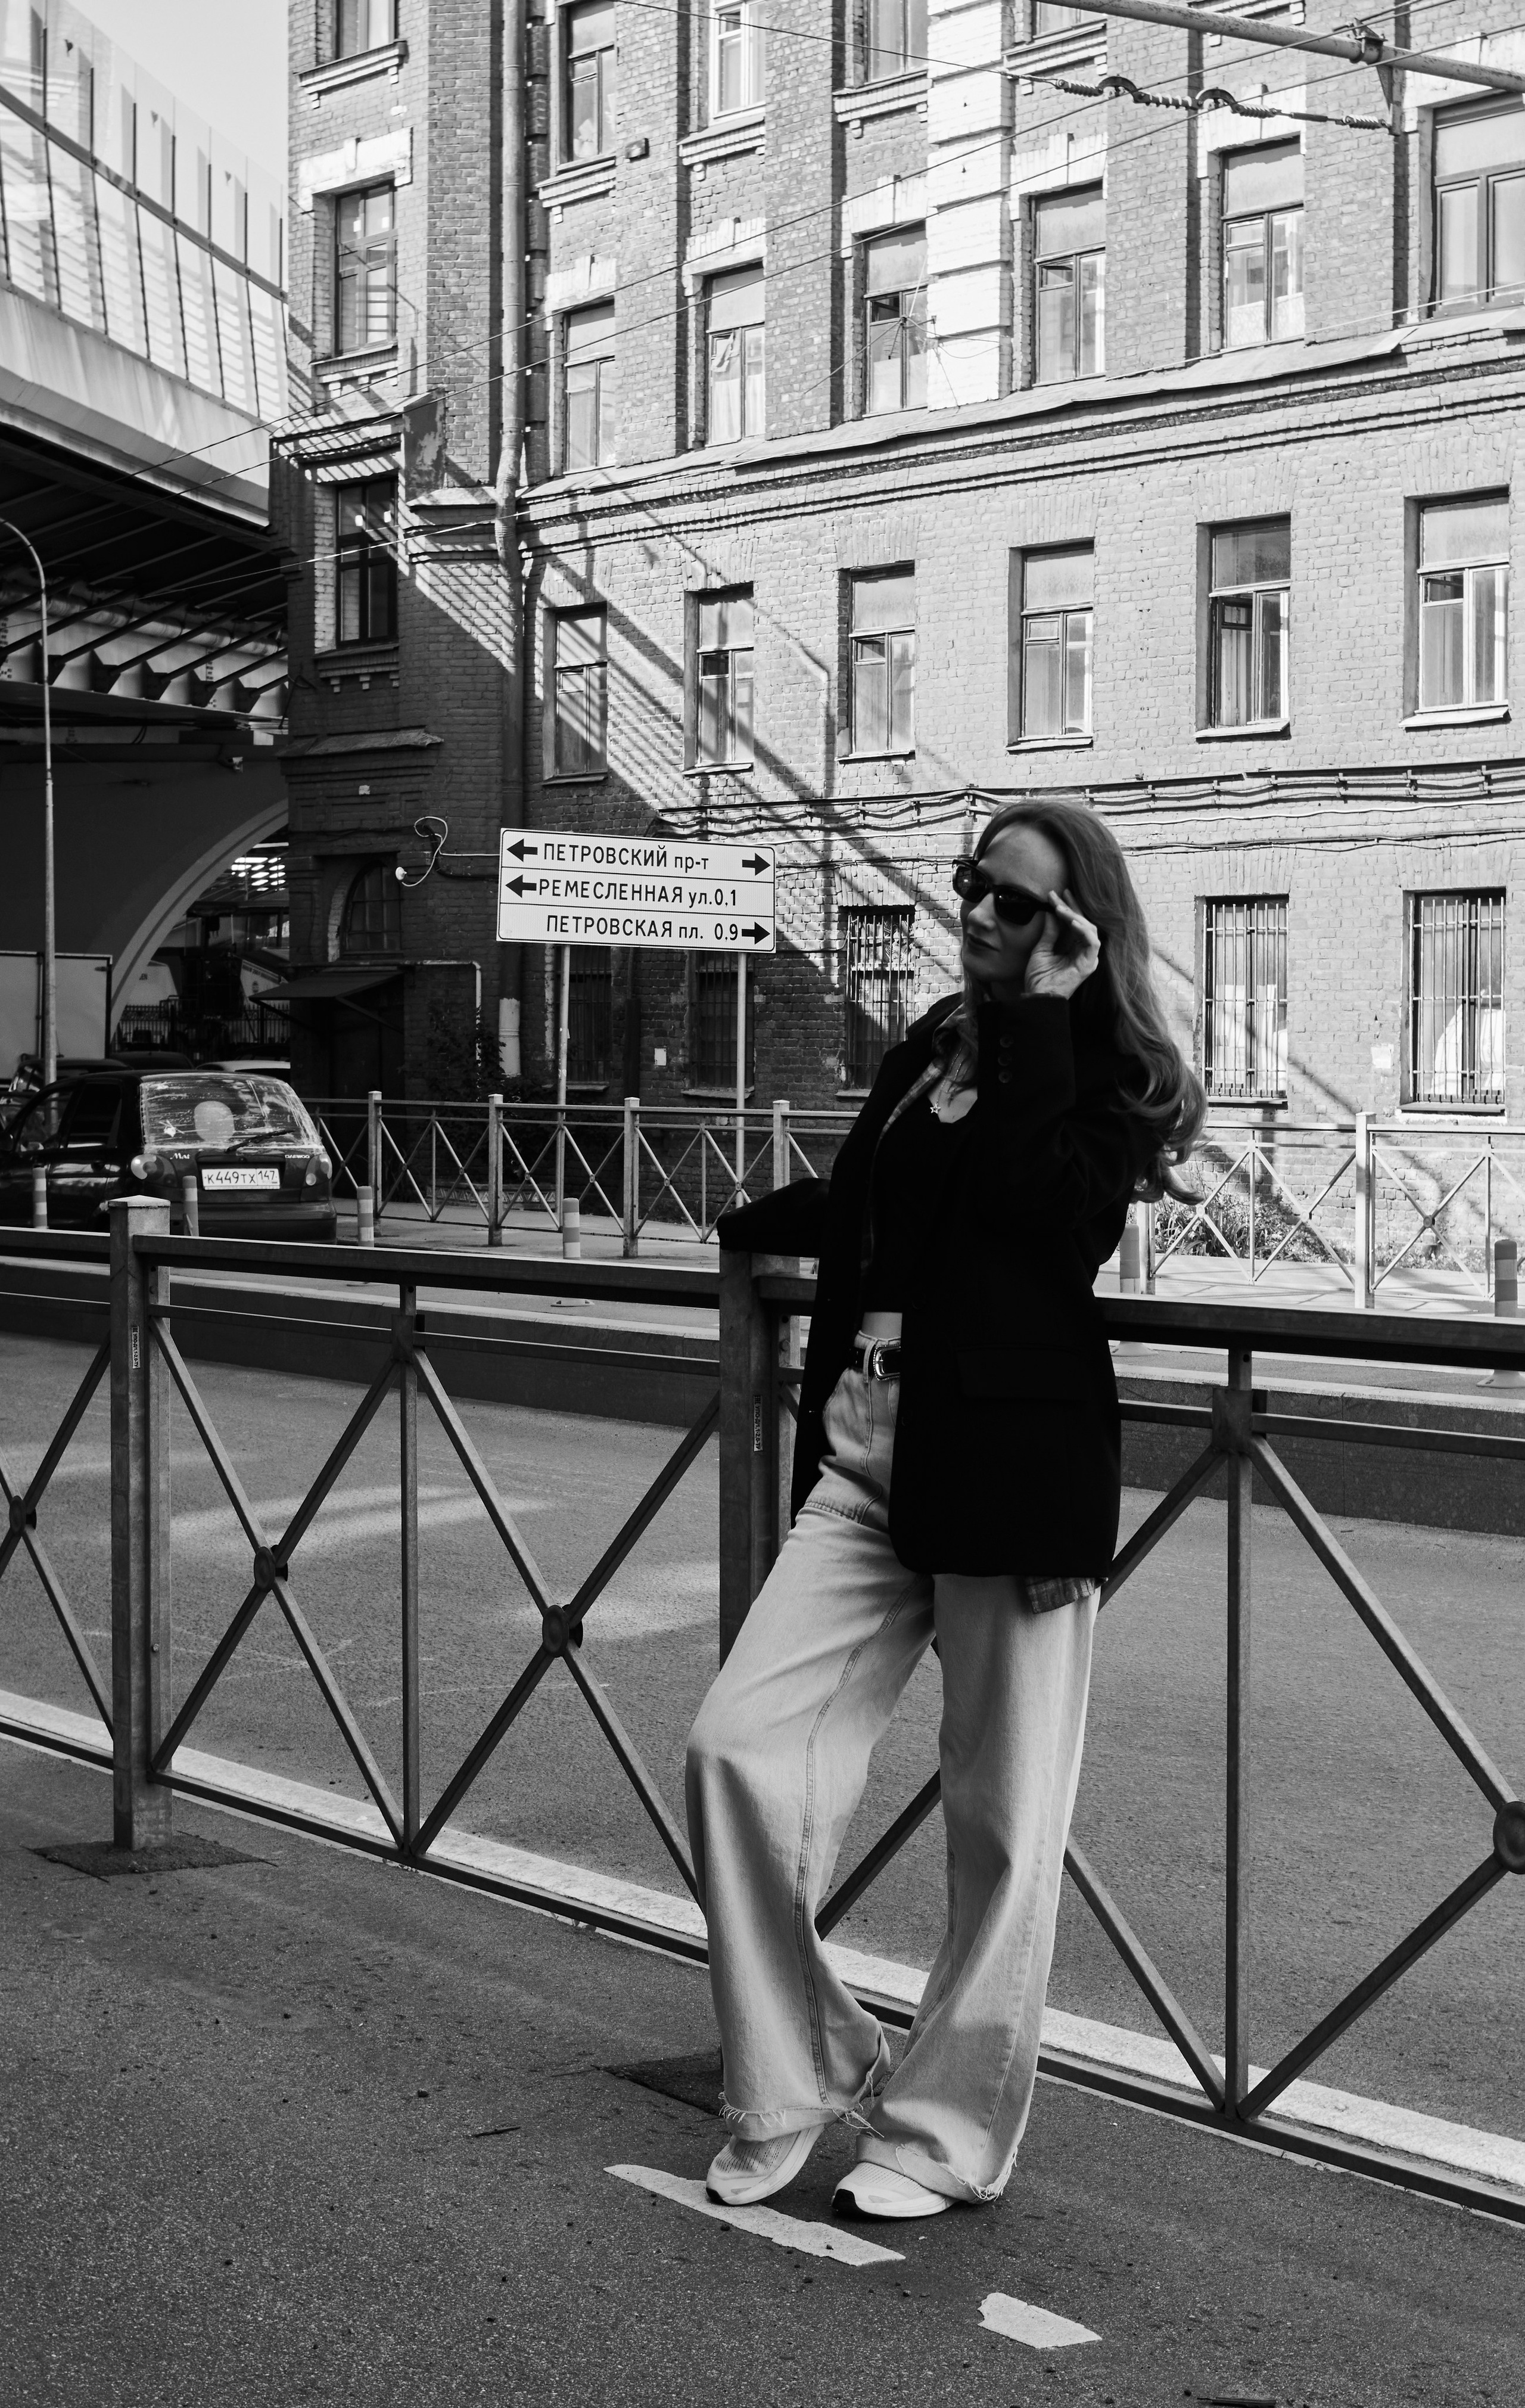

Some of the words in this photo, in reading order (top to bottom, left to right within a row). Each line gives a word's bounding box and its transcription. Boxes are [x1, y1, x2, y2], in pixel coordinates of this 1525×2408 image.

[544, 843, 667, 868] ПЕТРОВСКИЙ
[674, 856, 709, 874] пр-т
[539, 878, 682, 903] РЕМЕСЛЕННАЯ
[547, 915, 672, 938] ПЕТРОВСКАЯ
[679, 926, 704, 940] пл.
[258, 1170, 275, 1180] 147
